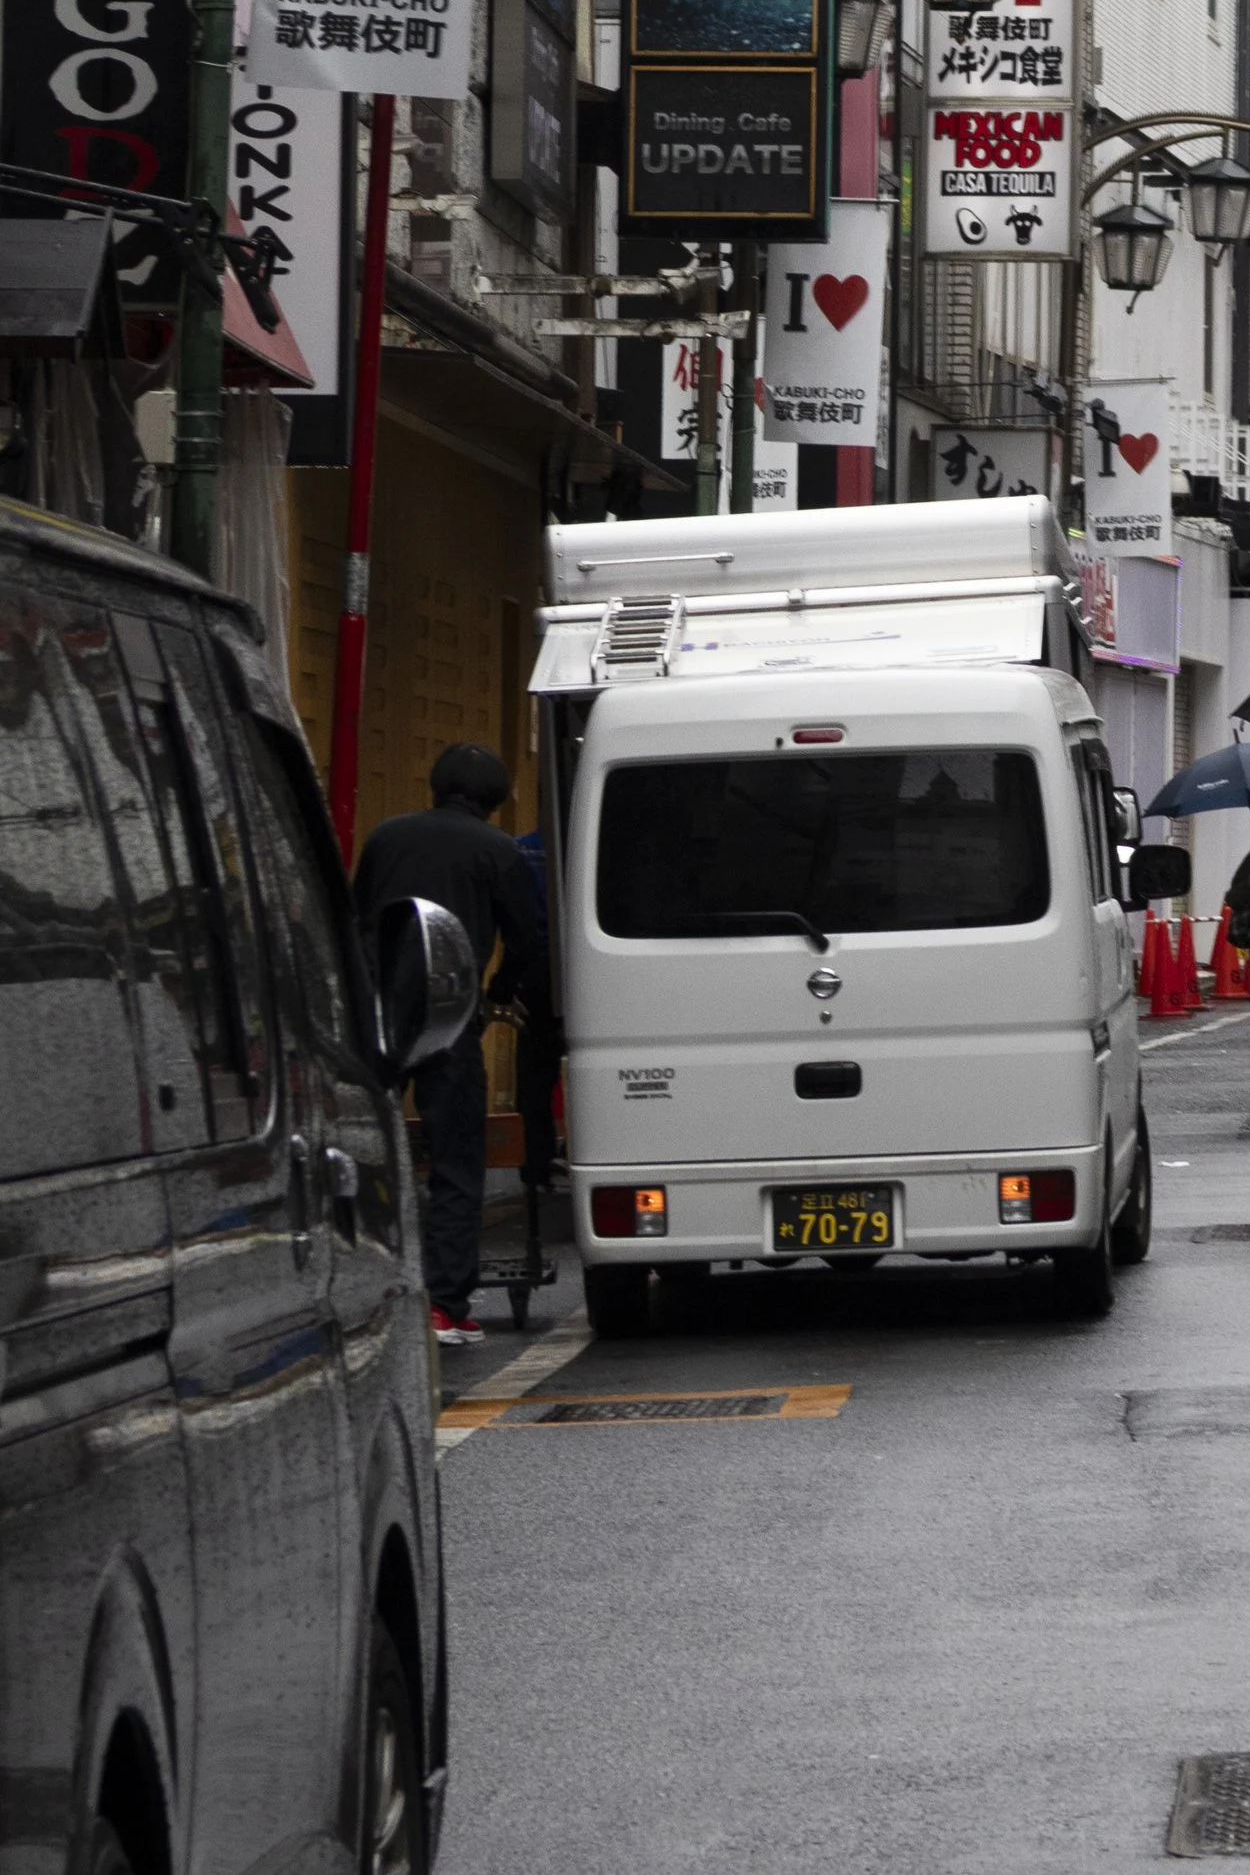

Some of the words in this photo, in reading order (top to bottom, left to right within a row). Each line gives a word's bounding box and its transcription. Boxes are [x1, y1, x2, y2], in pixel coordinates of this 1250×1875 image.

[275, 8, 448, 59] 歌舞伎町
[948, 17, 1053, 42] 歌舞伎町
[937, 45, 1063, 86] メキシコ食堂
[654, 112, 725, 134] Dining
[738, 112, 792, 132] Cafe
[934, 111, 1064, 142] MEXICAN
[642, 144, 803, 176] UPDATE
[955, 138, 1042, 169] FOOD
[944, 172, 986, 194] CASA
[991, 172, 1055, 196] TEQUILA
[783, 272, 810, 333] I
[772, 385, 866, 400] KABUKI-CHO
[772, 400, 865, 424] 歌舞伎町
[1095, 514, 1163, 524] KABUKI-CHO
[1094, 526, 1162, 542] 歌舞伎町
[618, 1068, 676, 1082] NV100
[799, 1211, 890, 1246] 70-79
